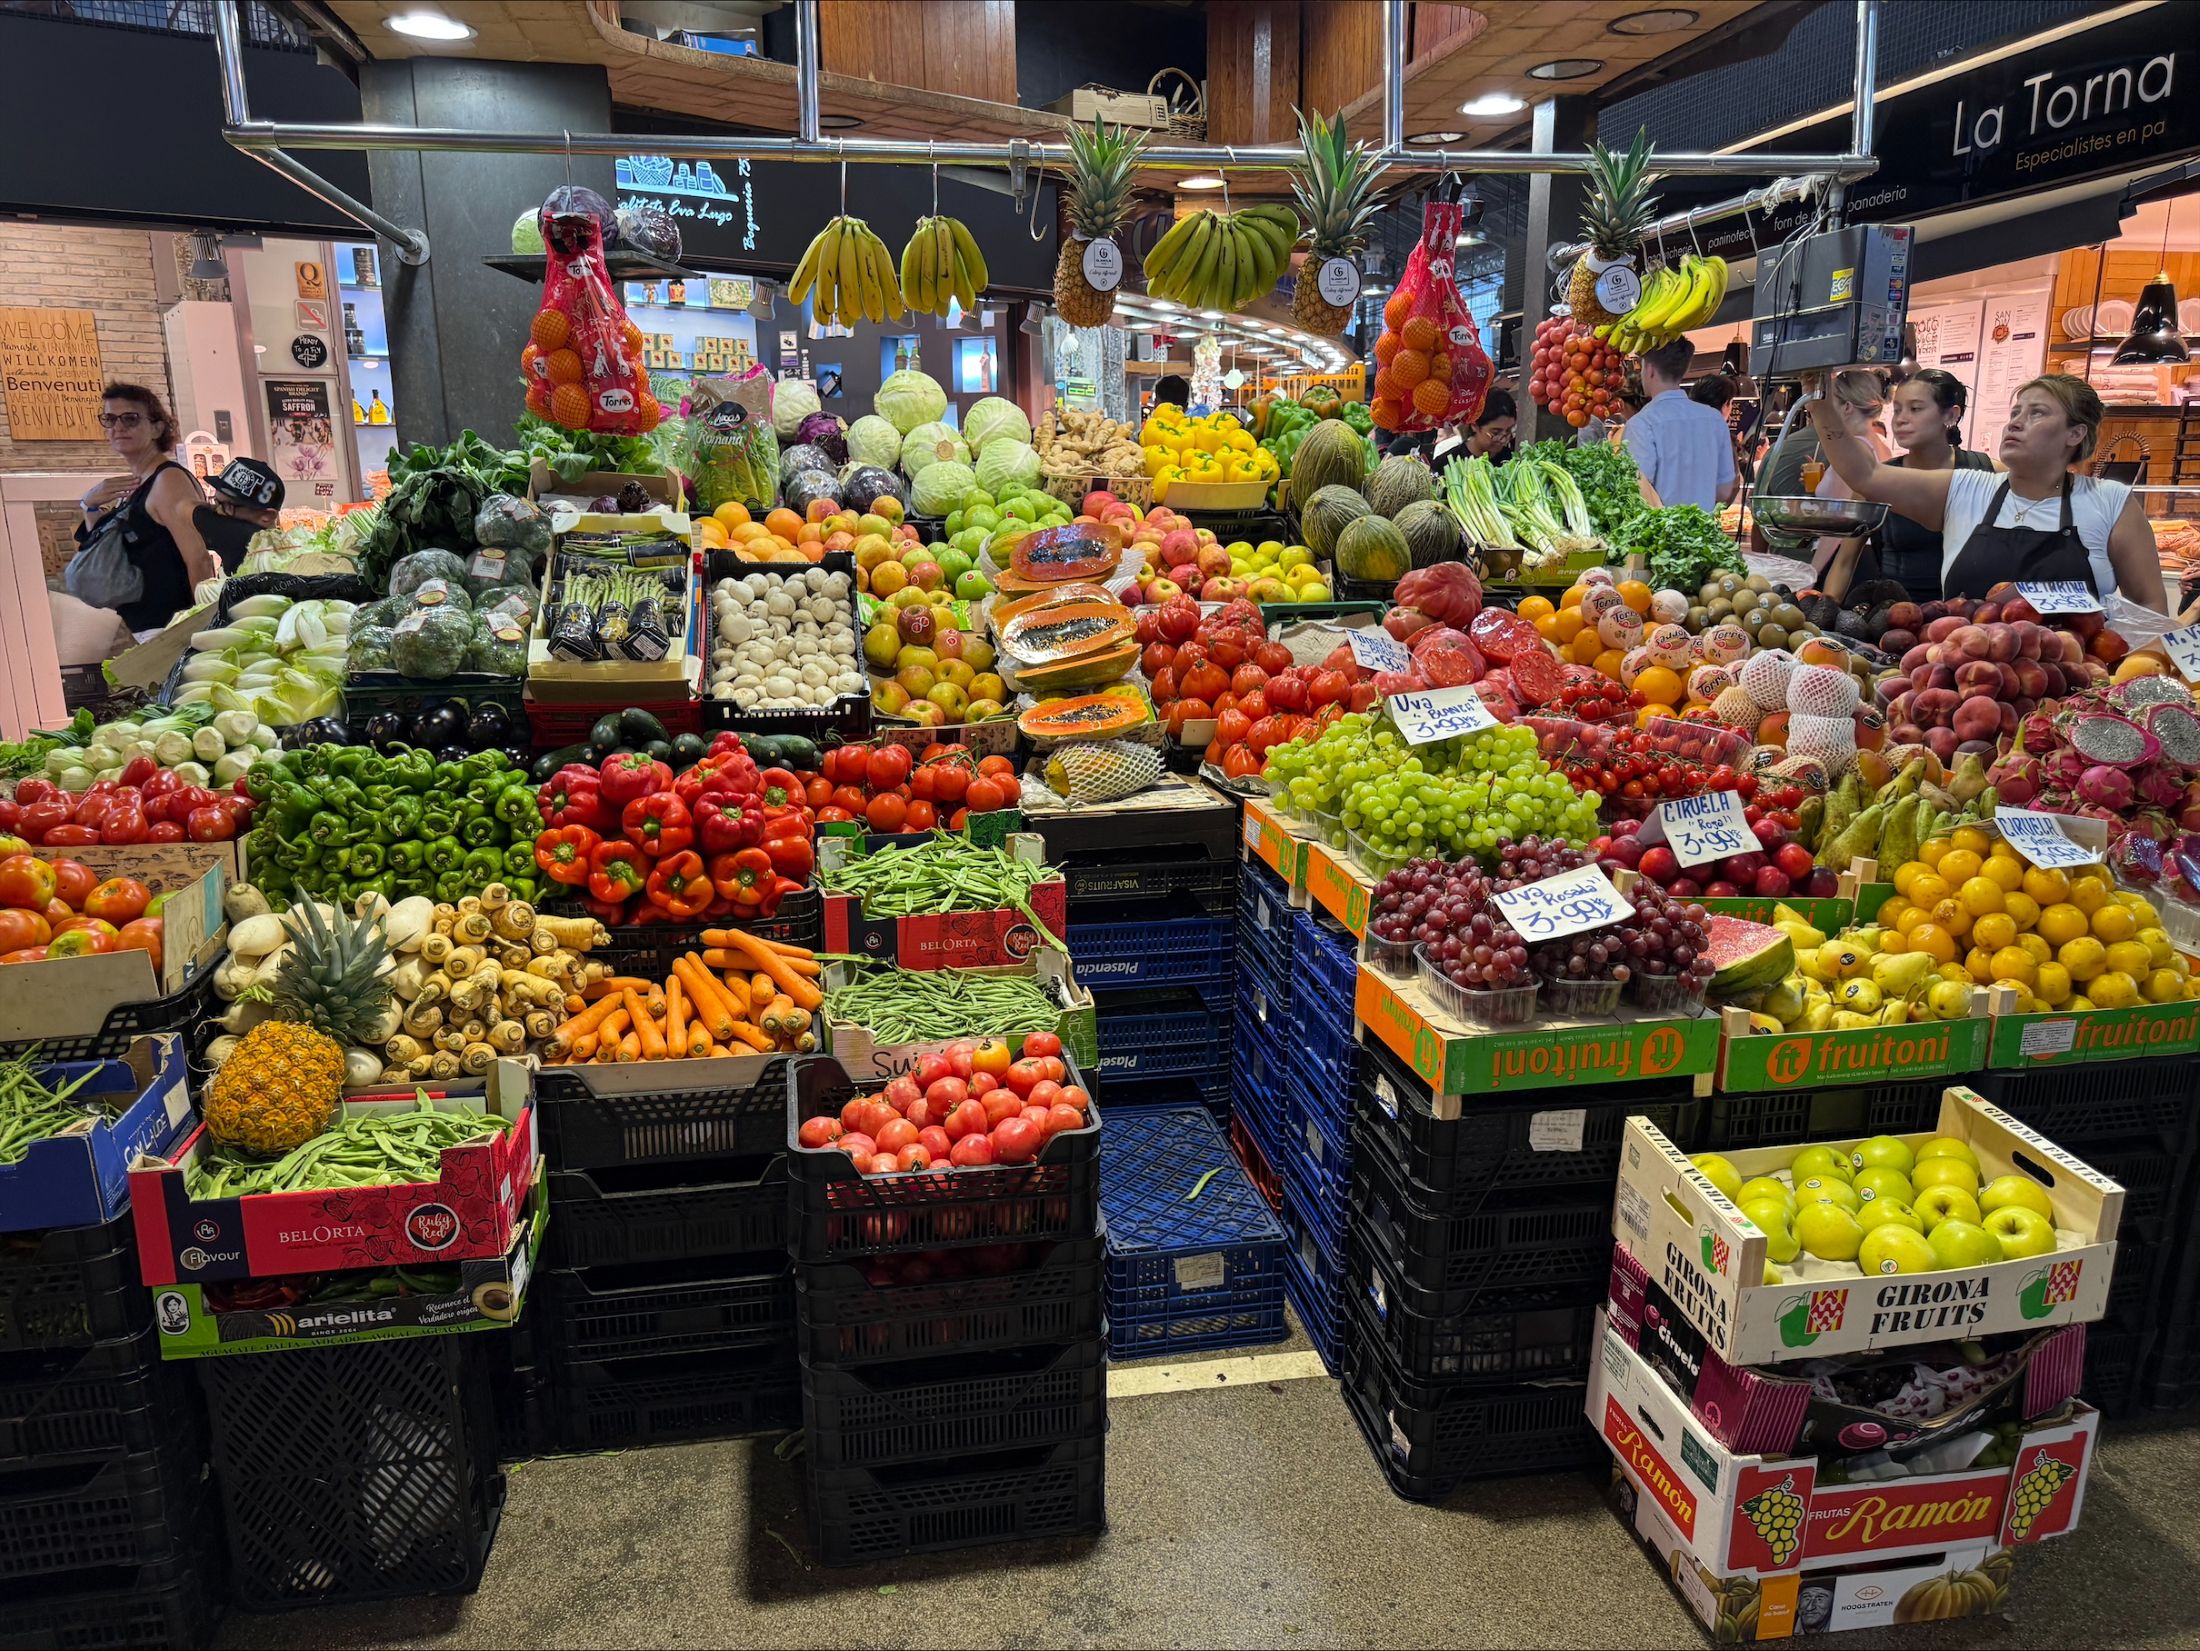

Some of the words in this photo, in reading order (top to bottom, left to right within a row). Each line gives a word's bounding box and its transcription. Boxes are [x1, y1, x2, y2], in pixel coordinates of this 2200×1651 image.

[1952, 101, 2004, 157] La
[2023, 52, 2176, 136] Torna
[2015, 133, 2112, 172] Especialistes
[2116, 127, 2136, 145] en
[2141, 120, 2166, 145] pa
[1847, 185, 1907, 213] panaderia
[668, 200, 695, 216] Eva
[697, 201, 734, 227] Lugo
[742, 181, 761, 251] Boqueria
[1774, 215, 1793, 232] forn
[1795, 211, 1808, 225] de
[1707, 226, 1756, 253] paninoteca
[0, 321, 95, 341] WELCOME
[310, 346, 321, 354] FLY
[7, 377, 102, 392] Benvenuti
[282, 402, 316, 412] SAFFRON
[602, 394, 632, 408] Torres
[698, 429, 743, 446] Romana
[1394, 694, 1433, 712] Uva
[1663, 792, 1731, 823] CIRUELA
[1996, 816, 2060, 838] CIRUELA
[1675, 829, 1741, 856] 3.99
[1087, 879, 1140, 891] VISAFRUITS
[1499, 887, 1544, 905] Uva
[1517, 899, 1605, 934] 3.99
[919, 938, 978, 951] BELORTA
[1076, 962, 1139, 976] Plasencia
[2075, 1006, 2200, 1049] fruitoni
[1818, 1026, 1952, 1072] fruitoni
[1491, 1039, 1633, 1089] fruitoni
[1641, 1124, 1688, 1163] FRUITS
[1983, 1107, 2042, 1144] GIRONA
[2042, 1145, 2109, 1185] FRUITS
[1683, 1168, 1734, 1211] GIRONA
[279, 1225, 365, 1243] BELORTA
[418, 1213, 452, 1229] Ruby
[422, 1224, 446, 1240] Red
[189, 1250, 241, 1264] Flavour
[1666, 1241, 1727, 1325] GIRONA
[1876, 1276, 1990, 1309] GIRONA
[298, 1308, 393, 1328] arielita
[456, 1304, 479, 1318] origen
[1664, 1263, 1727, 1350] FRUITS
[1868, 1301, 1987, 1336] FRUITS
[200, 1345, 257, 1357] AGUACATE
[265, 1342, 300, 1351] PALTA
[311, 1335, 361, 1346] AVOCADO
[1658, 1324, 1700, 1377] ciruelo
[1616, 1424, 1691, 1524] Ramón
[1808, 1507, 1851, 1521] FRUTAS
[1824, 1490, 1993, 1544] Ramón
